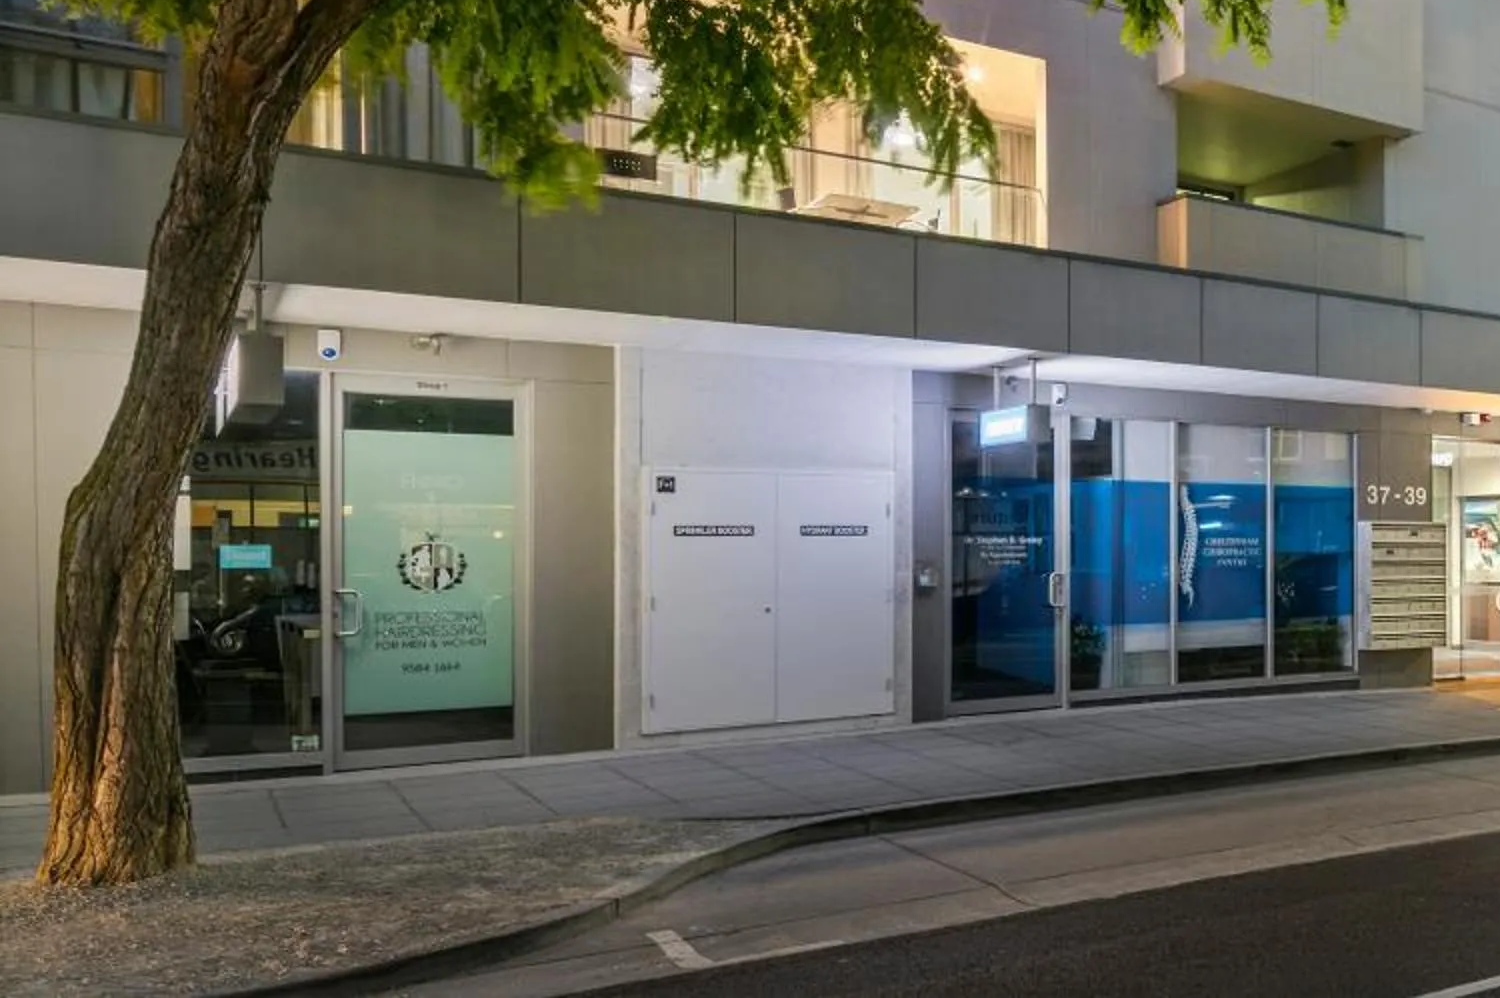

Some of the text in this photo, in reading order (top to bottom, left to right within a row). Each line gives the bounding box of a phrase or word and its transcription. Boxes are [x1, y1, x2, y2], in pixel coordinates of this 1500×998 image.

[374, 611, 484, 624] PROFESSIONAL
[374, 624, 487, 639] HAIRDRESSING
[375, 640, 398, 651] FOR
[401, 640, 427, 650] MEN
[441, 637, 487, 649] WOMEN
